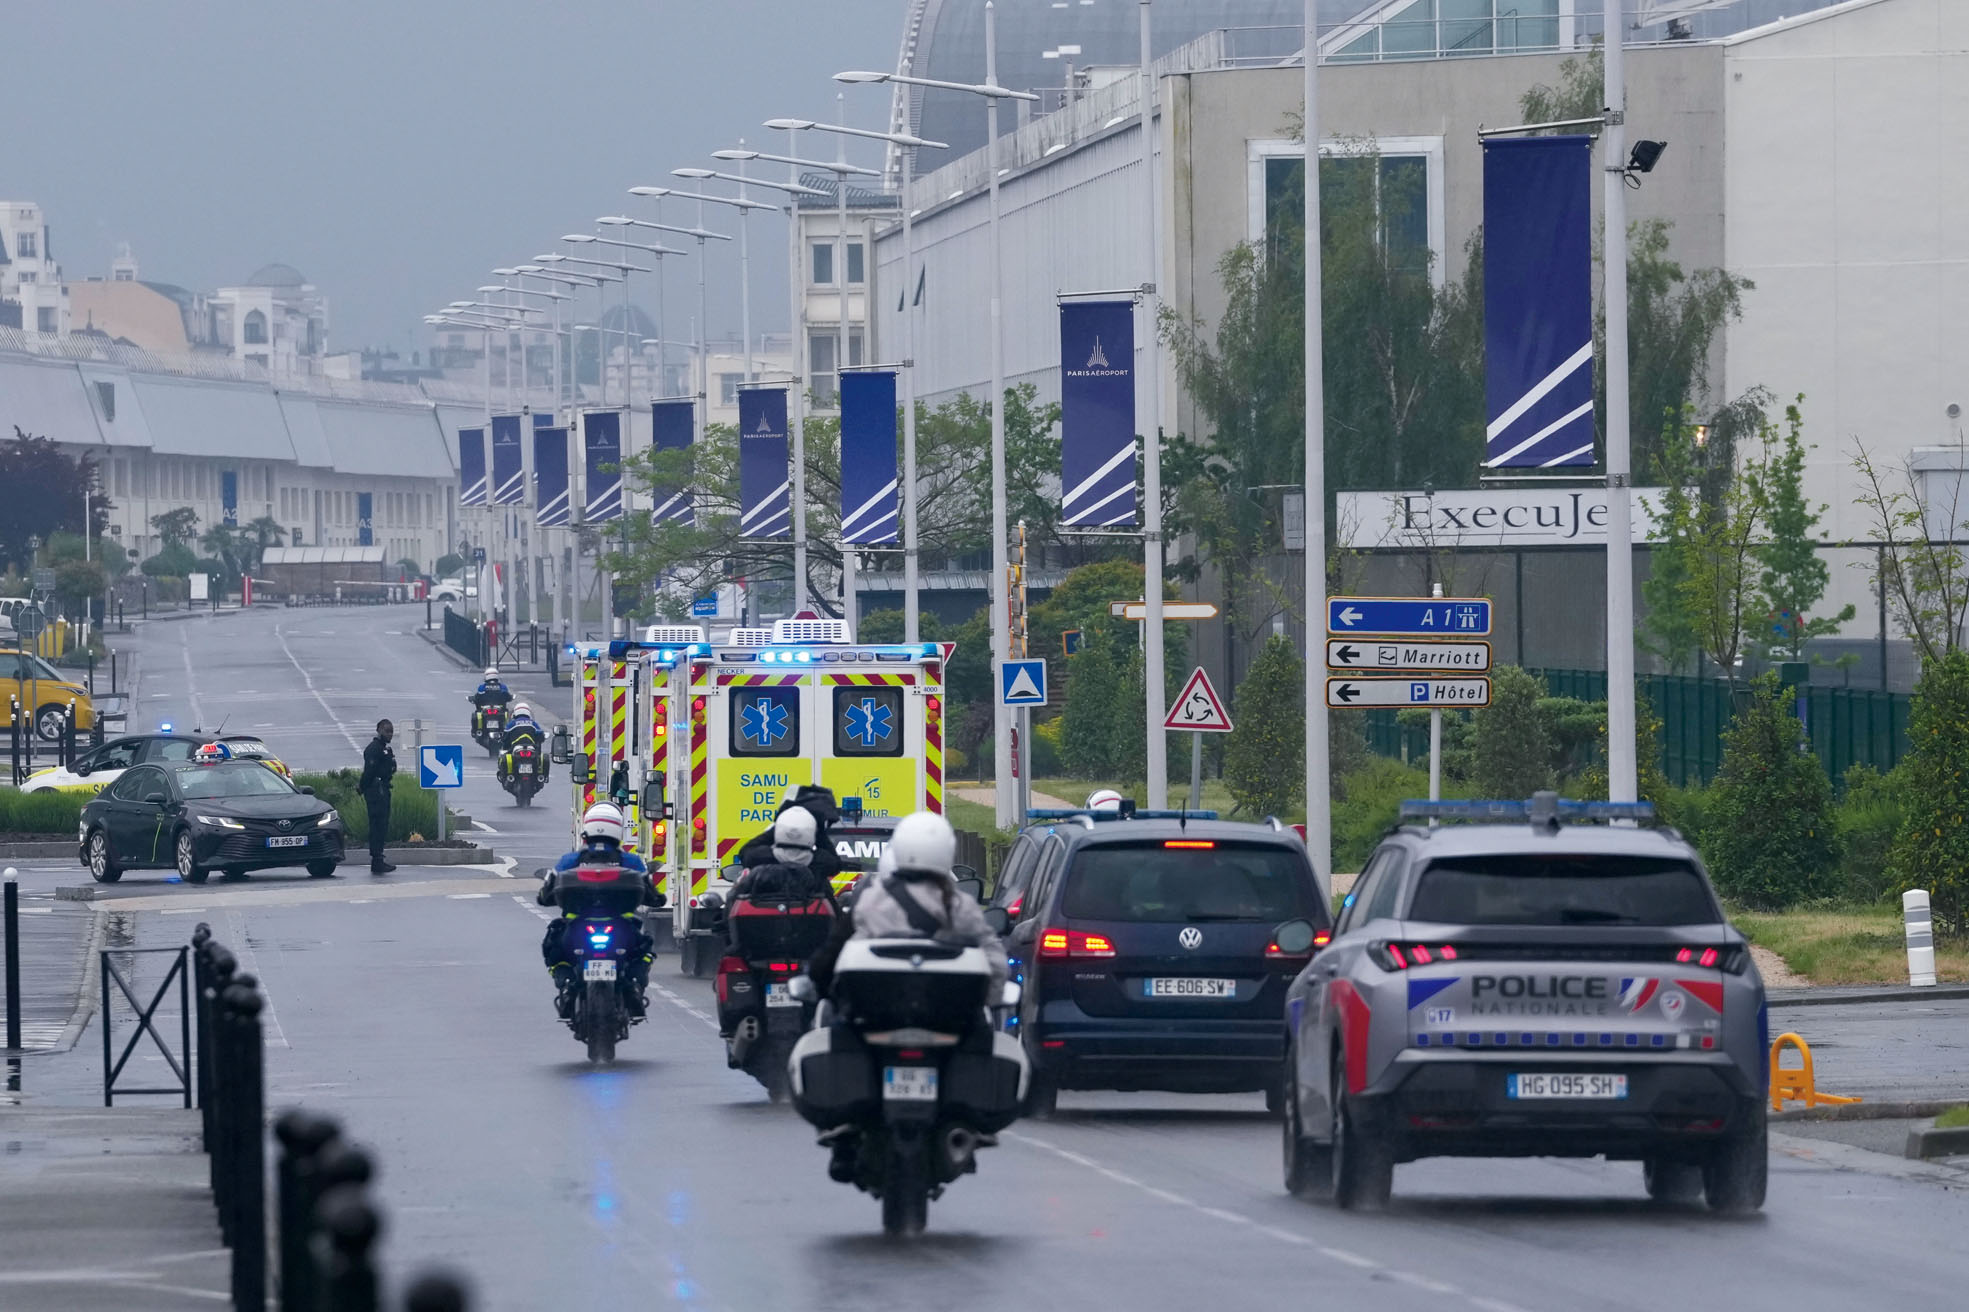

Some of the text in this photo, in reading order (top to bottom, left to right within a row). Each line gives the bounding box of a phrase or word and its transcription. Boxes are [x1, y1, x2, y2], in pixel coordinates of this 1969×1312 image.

[1401, 493, 1607, 539] ExecuJe
[1420, 608, 1434, 626] A
[1403, 649, 1480, 664] Marriott
[1434, 685, 1483, 699] Hôtel
[740, 774, 788, 787] SAMU
[753, 791, 775, 805] DE
[867, 787, 880, 799] 15
[1471, 975, 1608, 999] POLICE
[1438, 1010, 1451, 1022] 17
[1471, 1002, 1608, 1016] NATIONALE
